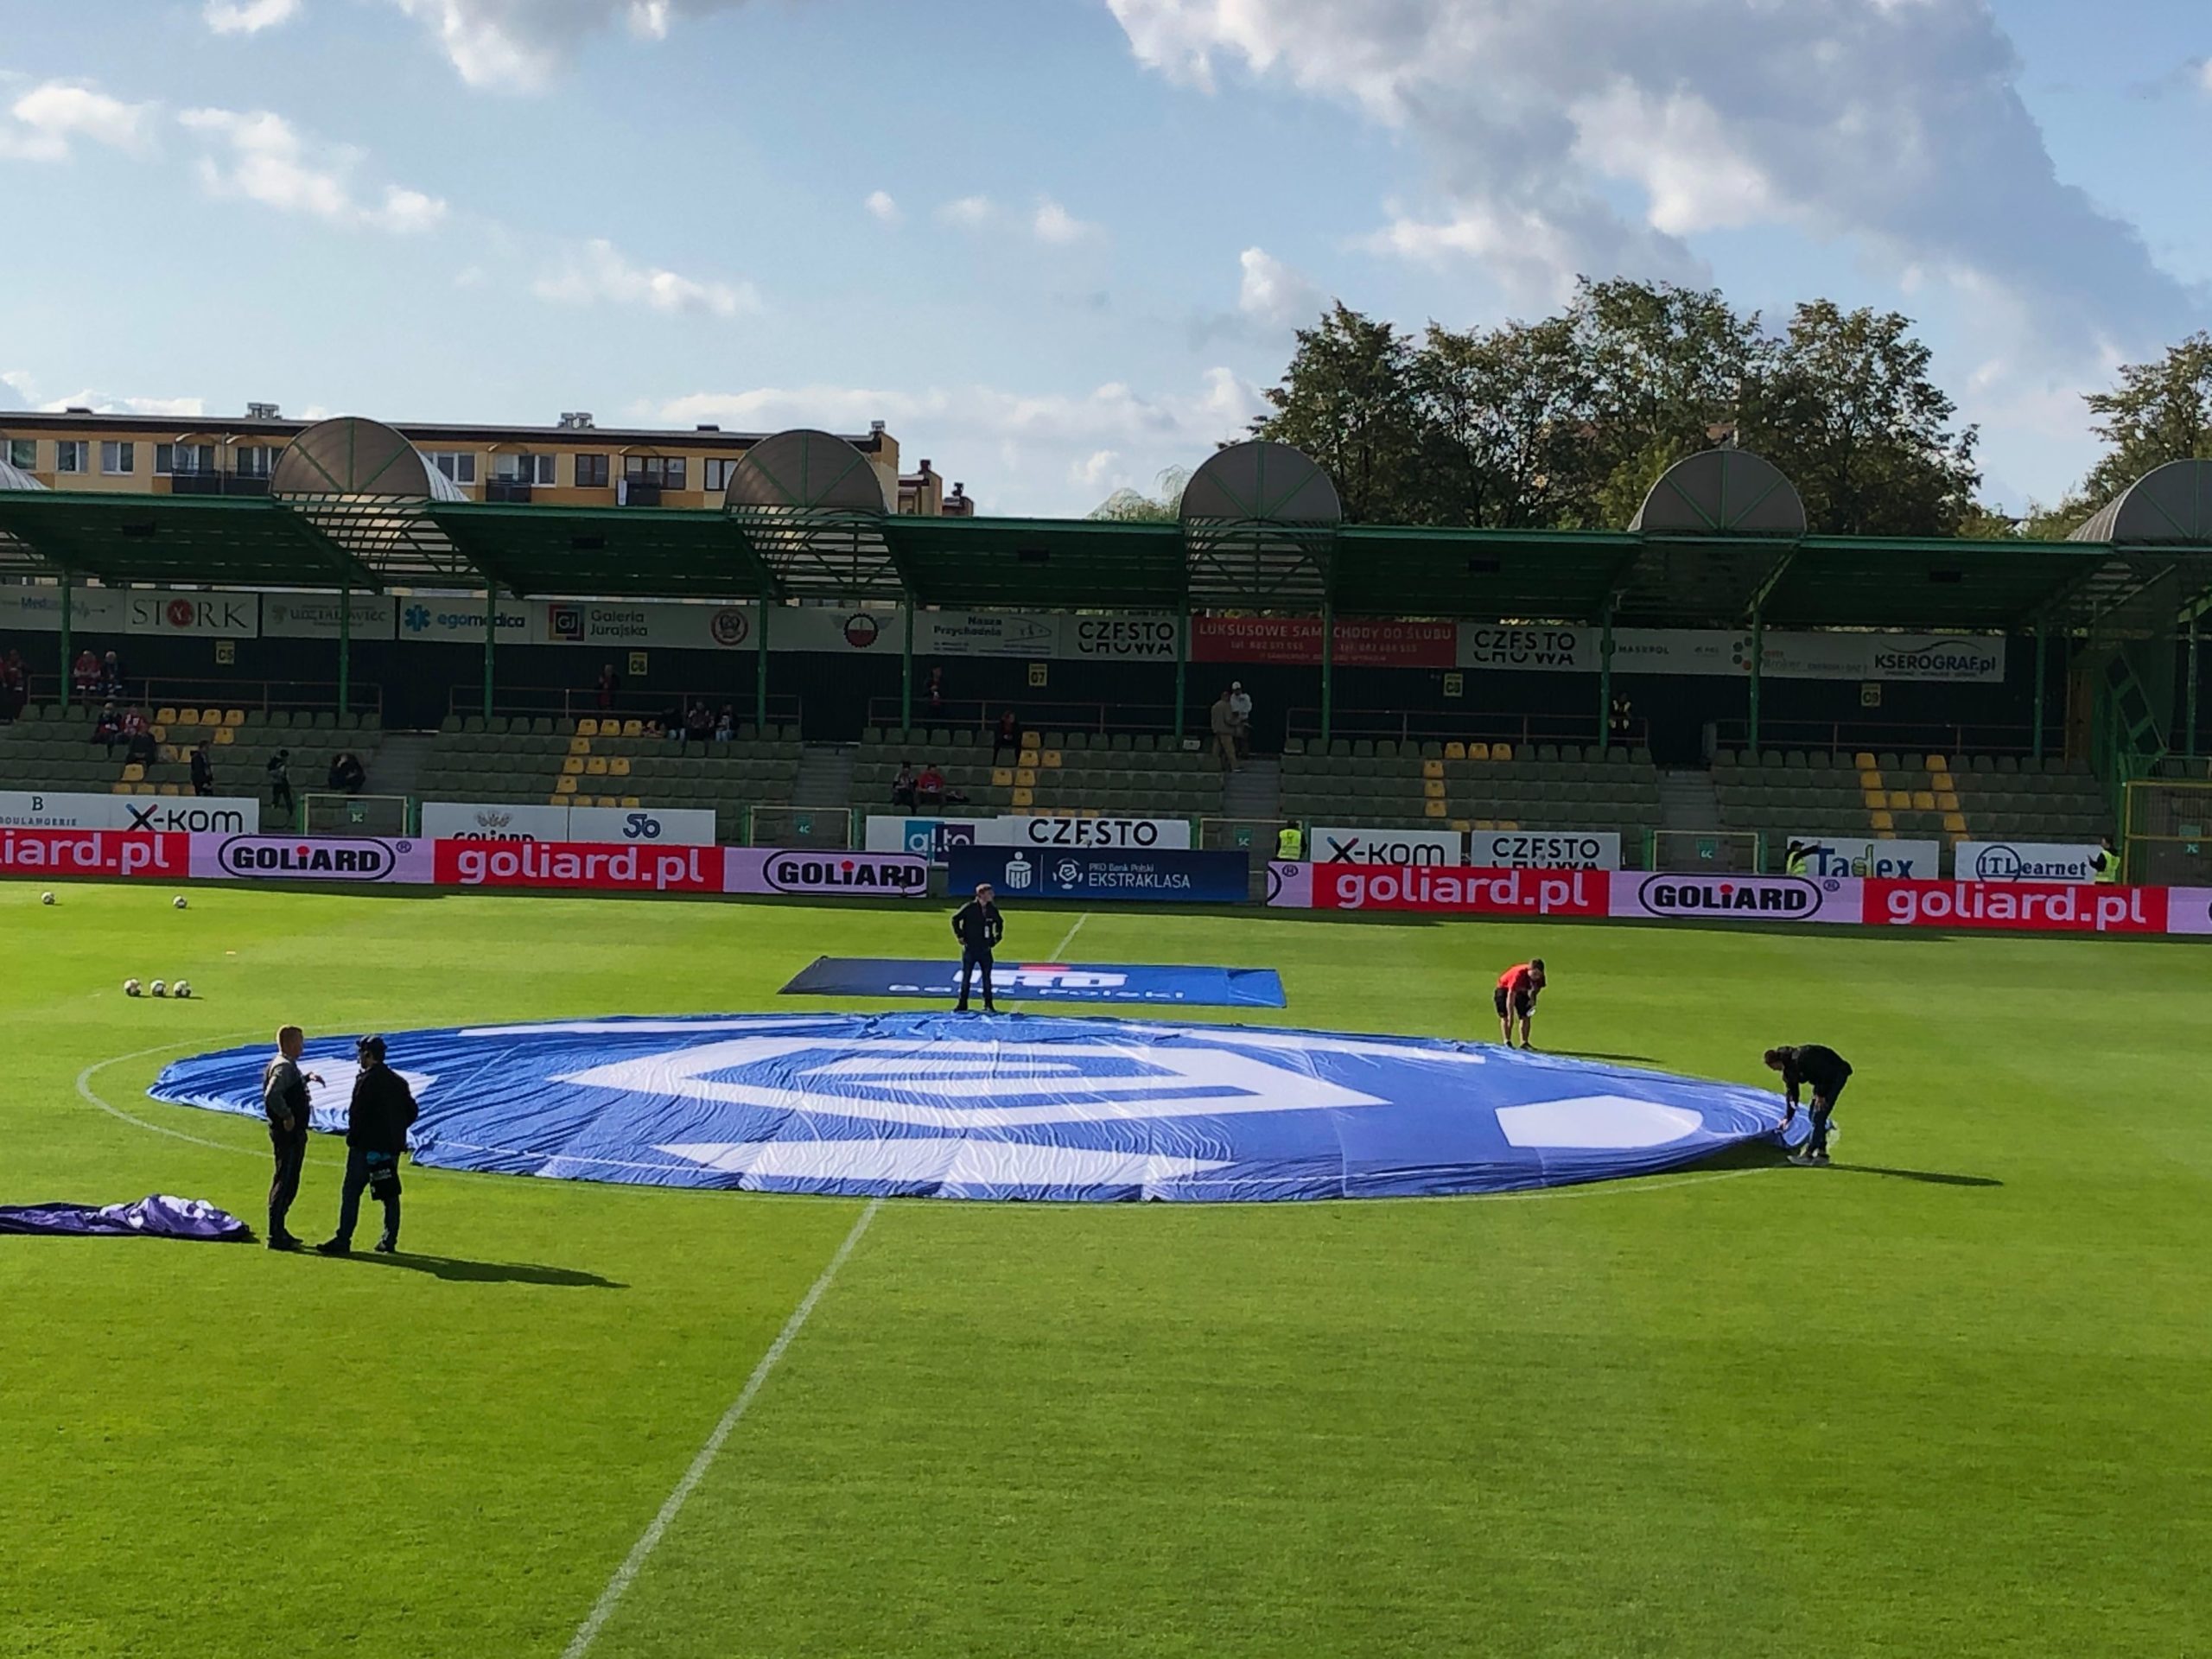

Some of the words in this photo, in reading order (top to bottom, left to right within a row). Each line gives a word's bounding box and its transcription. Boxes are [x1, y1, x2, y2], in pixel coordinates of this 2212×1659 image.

[591, 609, 645, 623] Galeria
[968, 616, 1002, 626] Nasza
[590, 622, 648, 638] Jurajska
[933, 626, 1002, 637] Przychodnia
[1198, 621, 1288, 637] LUKSUSOWE
[1292, 625, 1380, 639] SAMCHODY
[1875, 654, 1996, 675] KSEROGRAF.pl
[32, 796, 44, 811] B
[458, 843, 704, 890] goliard.pl
[1109, 862, 1129, 873] Bank
[1130, 862, 1154, 873] Polski
[1088, 872, 1192, 889] EKSTRAKLASA
[1337, 867, 1588, 914] goliard.pl
[1887, 883, 2147, 931] goliard.pl
